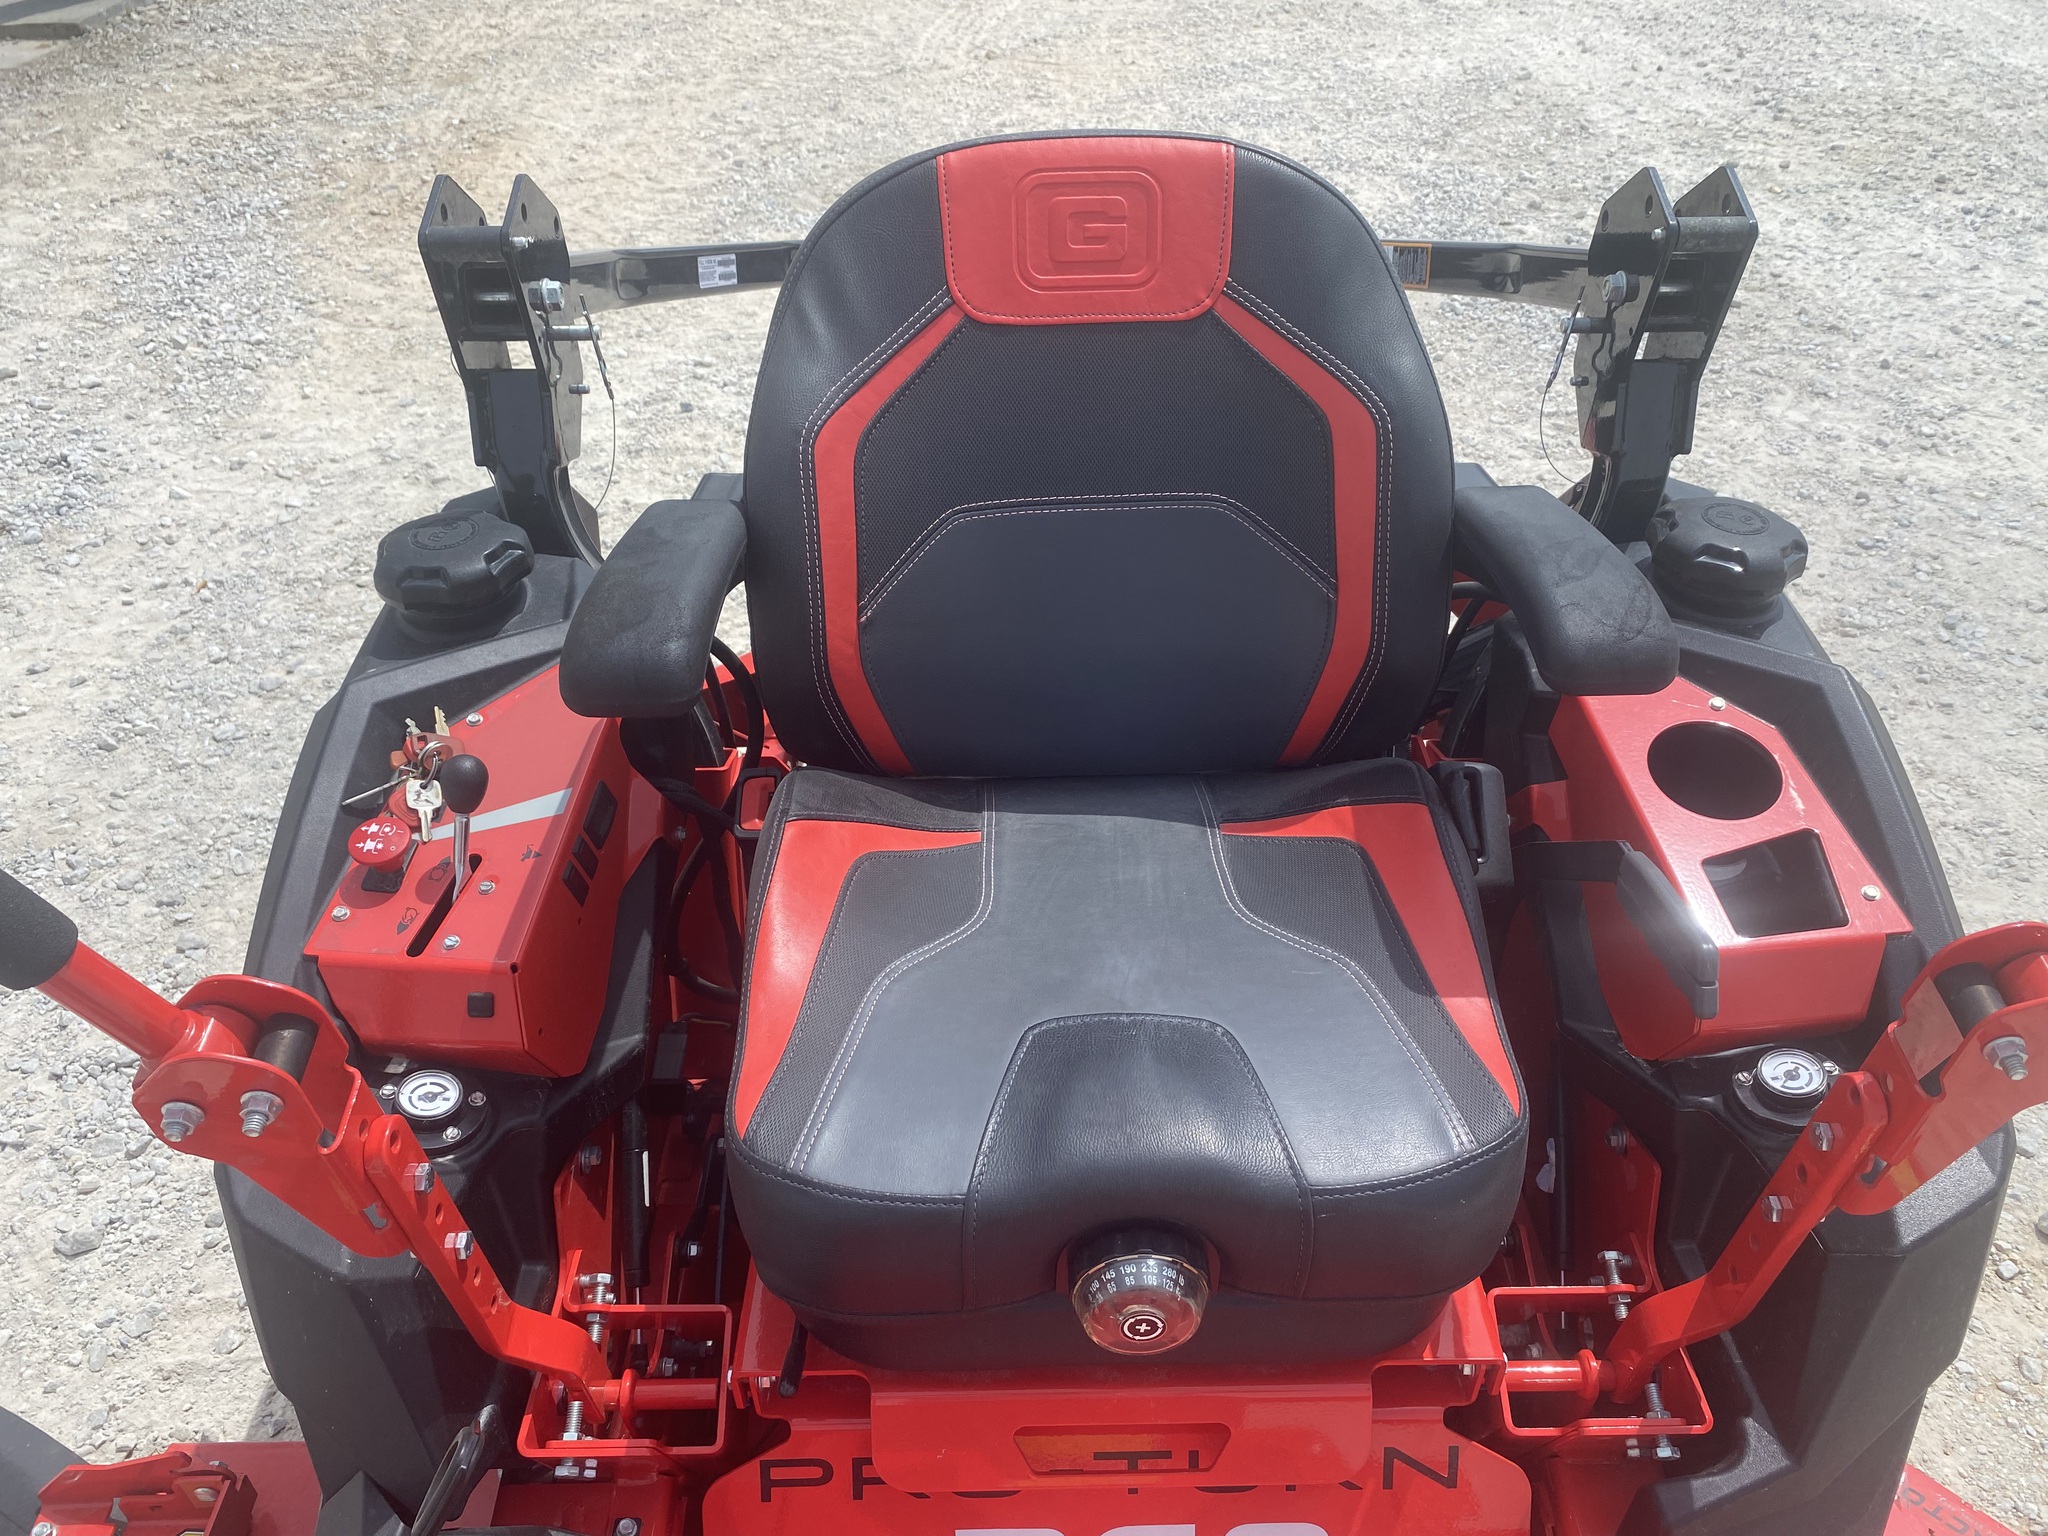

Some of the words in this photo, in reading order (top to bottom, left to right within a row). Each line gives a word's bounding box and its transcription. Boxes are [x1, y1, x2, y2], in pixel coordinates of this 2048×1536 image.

[1090, 1279, 1100, 1294] 100
[1100, 1269, 1116, 1283] 145
[1119, 1263, 1137, 1275] 190
[1141, 1262, 1158, 1273] 235
[1162, 1266, 1177, 1280] 280
[1179, 1273, 1185, 1287] lb
[1107, 1281, 1117, 1294] 65
[1125, 1275, 1136, 1286] 85
[1143, 1274, 1157, 1286] 105
[1163, 1278, 1174, 1292] 125
